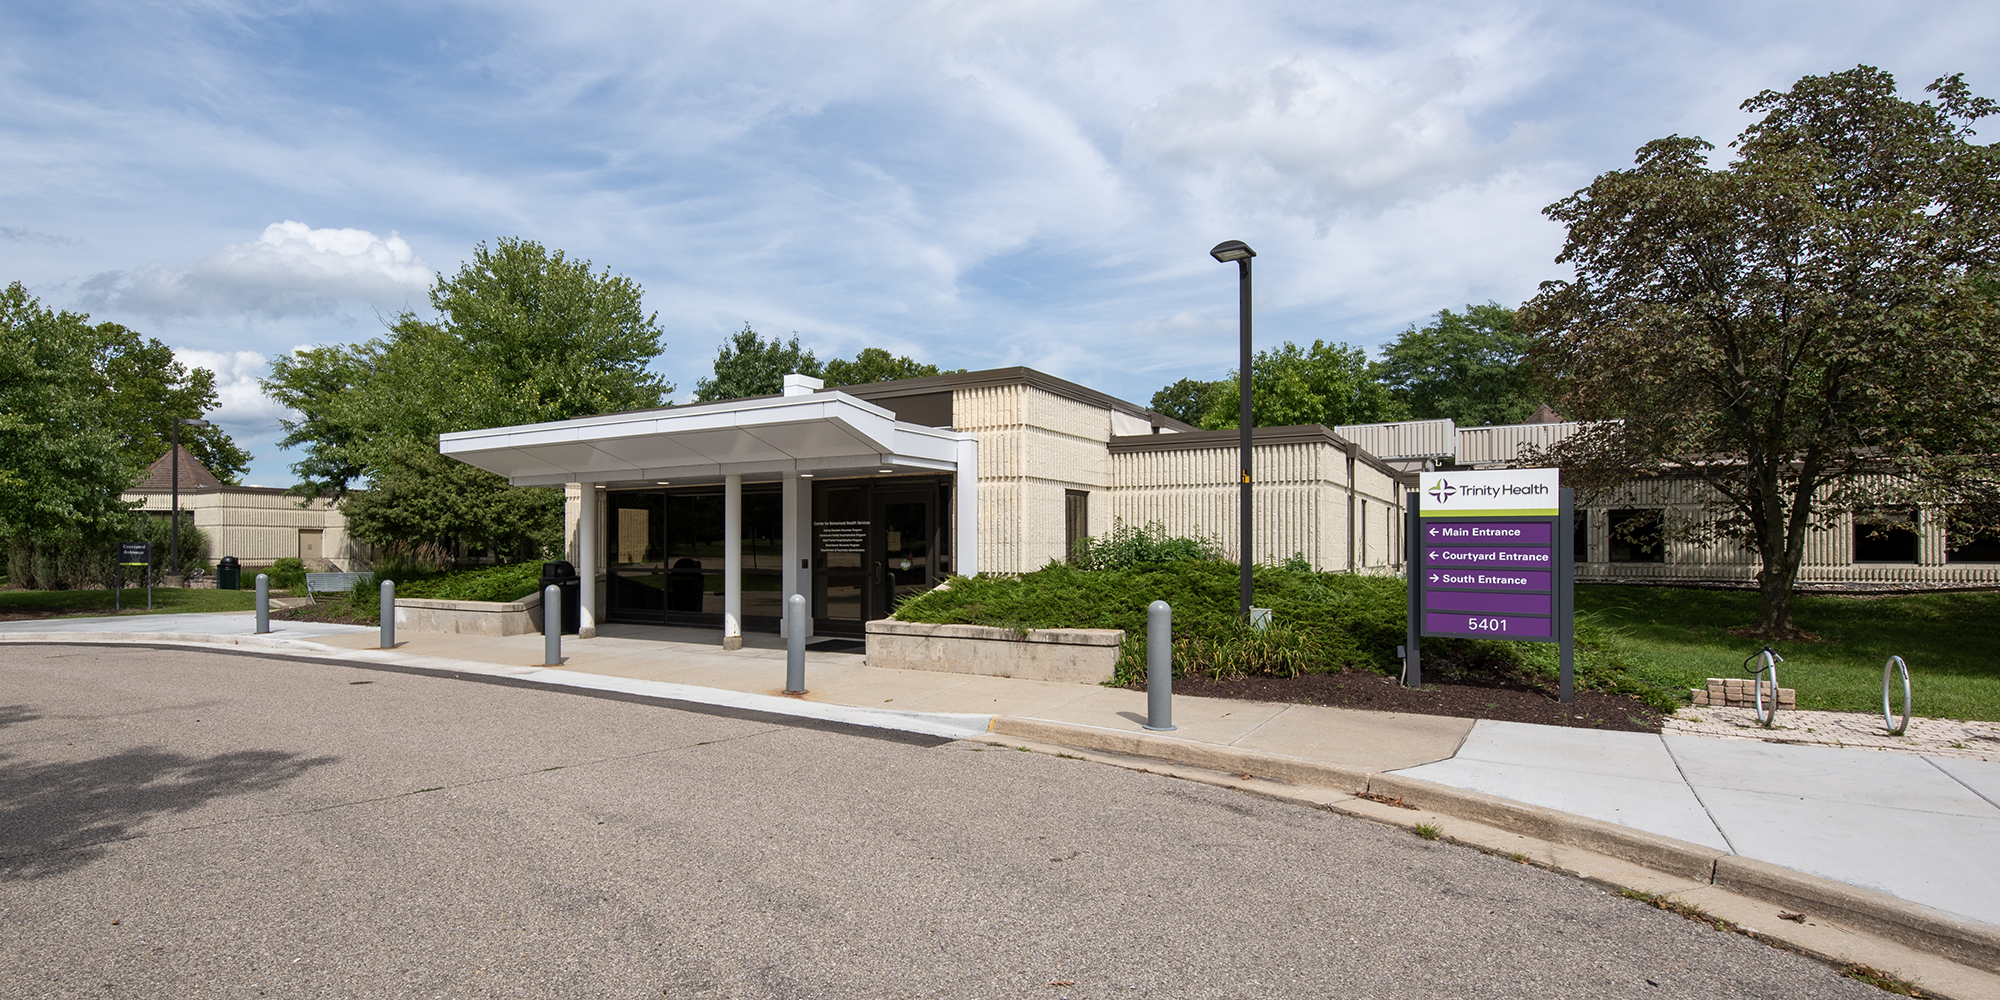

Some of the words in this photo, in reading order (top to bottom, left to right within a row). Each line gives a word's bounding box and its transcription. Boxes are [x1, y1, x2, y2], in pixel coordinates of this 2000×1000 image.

[1459, 484, 1501, 498] Trinity
[1502, 484, 1549, 496] Health
[1442, 527, 1469, 537] Main
[1472, 527, 1521, 537] Entrance
[1442, 550, 1496, 562] Courtyard
[1498, 552, 1549, 562] Entrance
[1442, 574, 1475, 584] South
[1478, 574, 1528, 585] Entrance
[1468, 618, 1507, 632] 5401
